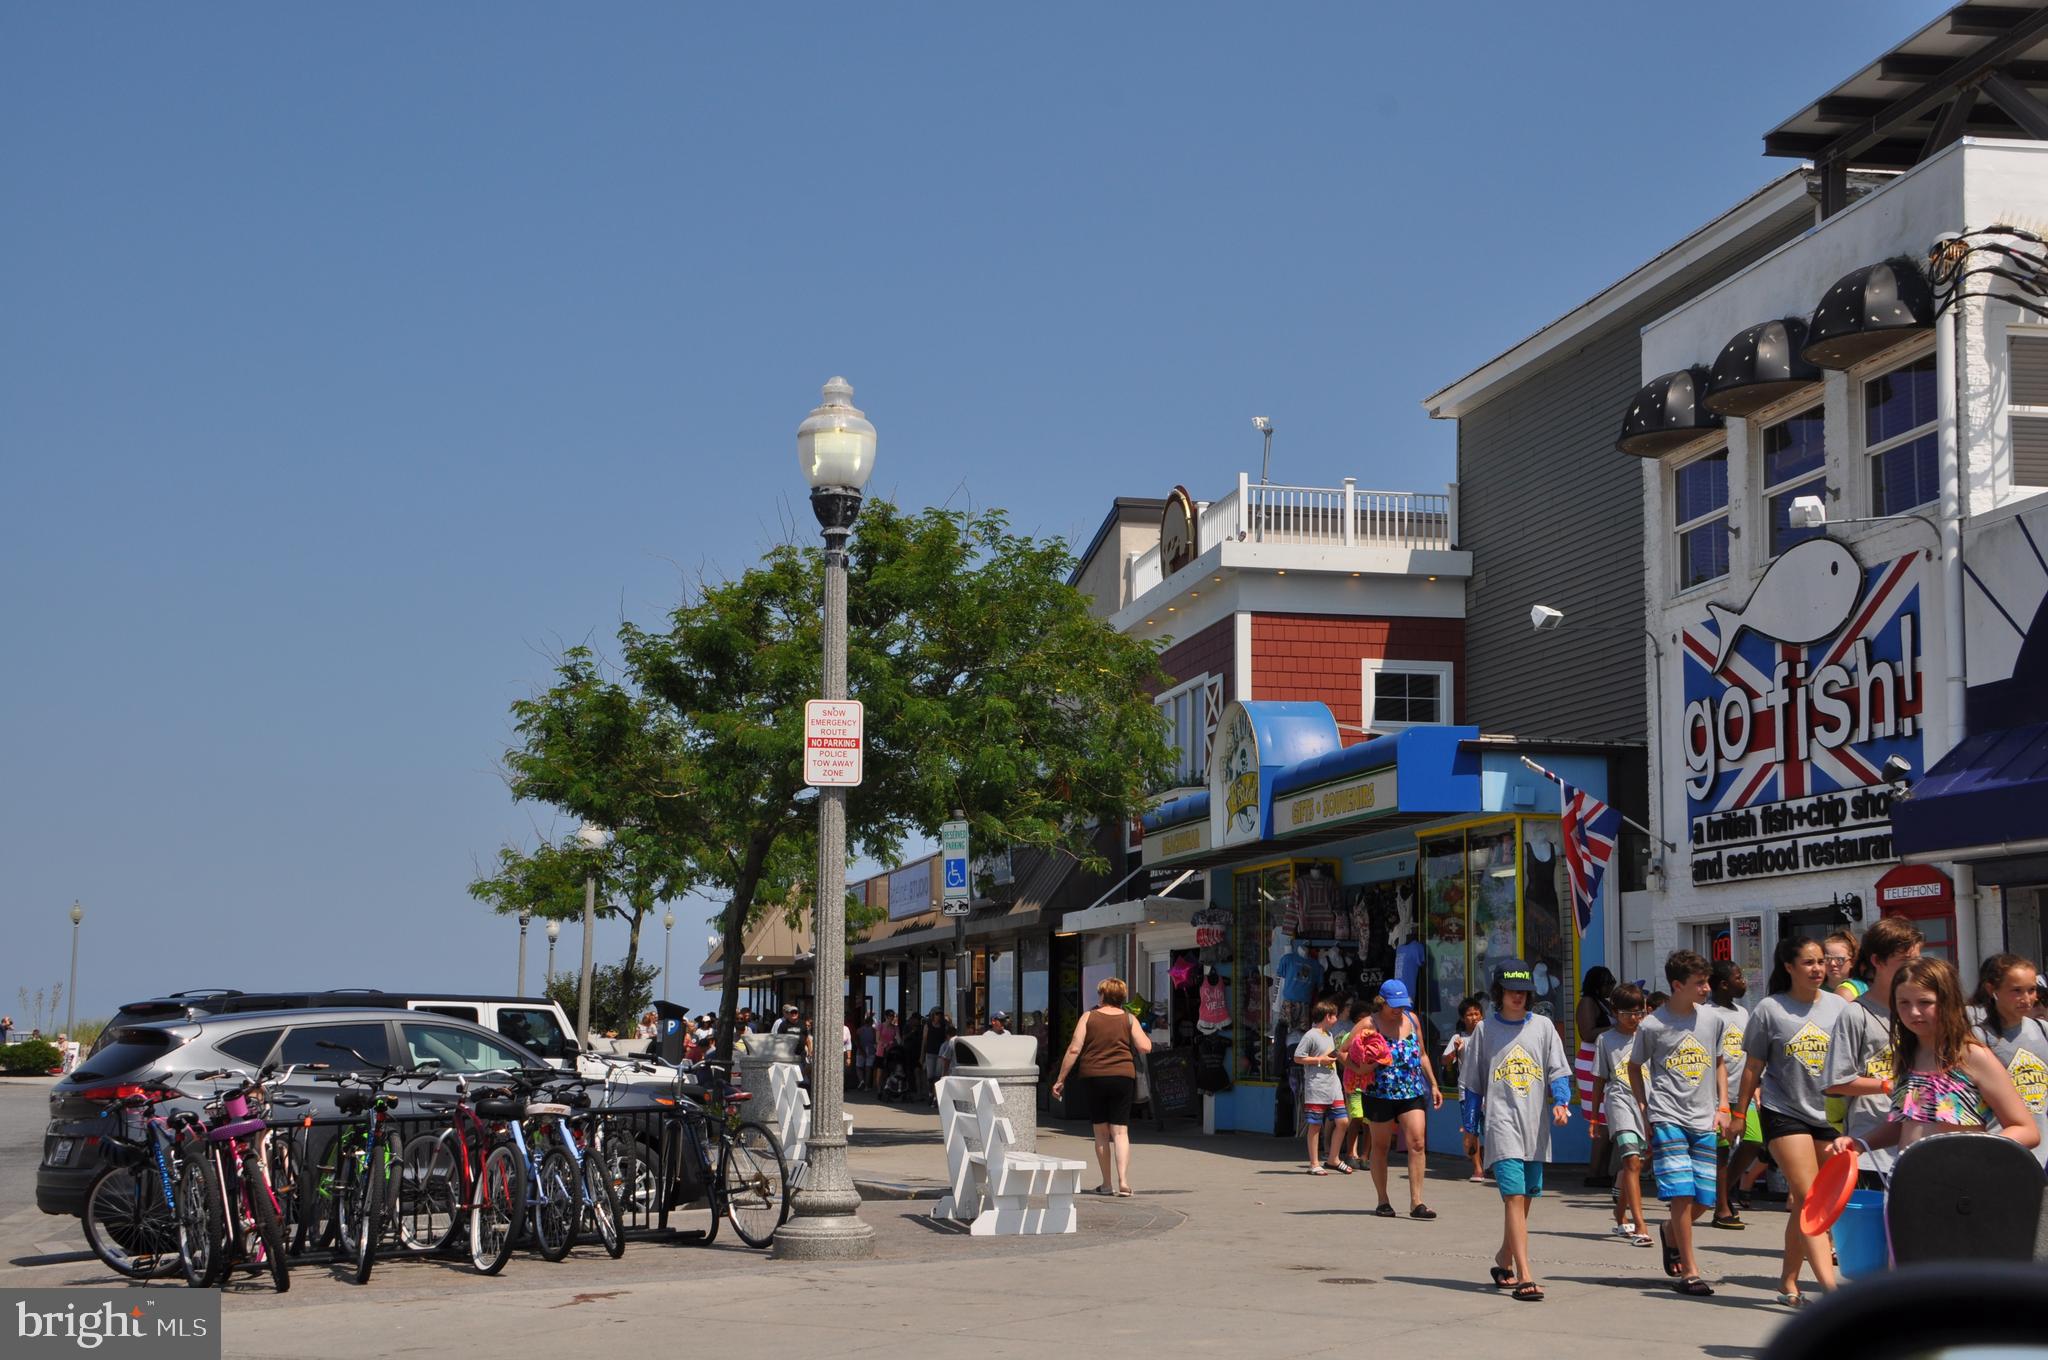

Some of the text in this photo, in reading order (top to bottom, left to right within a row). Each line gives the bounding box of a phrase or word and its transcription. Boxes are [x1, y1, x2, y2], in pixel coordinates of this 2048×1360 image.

[1684, 612, 1914, 800] go fish!
[822, 709, 846, 717] SNOW
[811, 718, 857, 727] EMERGENCY
[820, 728, 848, 736] ROUTE
[811, 738, 856, 748] NO PARKING
[819, 750, 848, 758] POLICE
[813, 759, 854, 768] TOW AWAY
[822, 769, 844, 777] ZONE
[1292, 782, 1375, 825] GIFTS SOUVENIRS
[1693, 821, 1704, 845] a
[1706, 810, 1757, 842] british
[1851, 788, 1894, 821] sho
[944, 830, 968, 839] RESERVED
[945, 841, 966, 849] PARKING
[1693, 833, 1898, 882] and seafood restauran
[1886, 883, 1940, 899] TELEPHONE
[1713, 936, 1731, 961] OPE
[1503, 970, 1527, 980] Hurley
[1493, 1064, 1543, 1082] ADVENTURE
